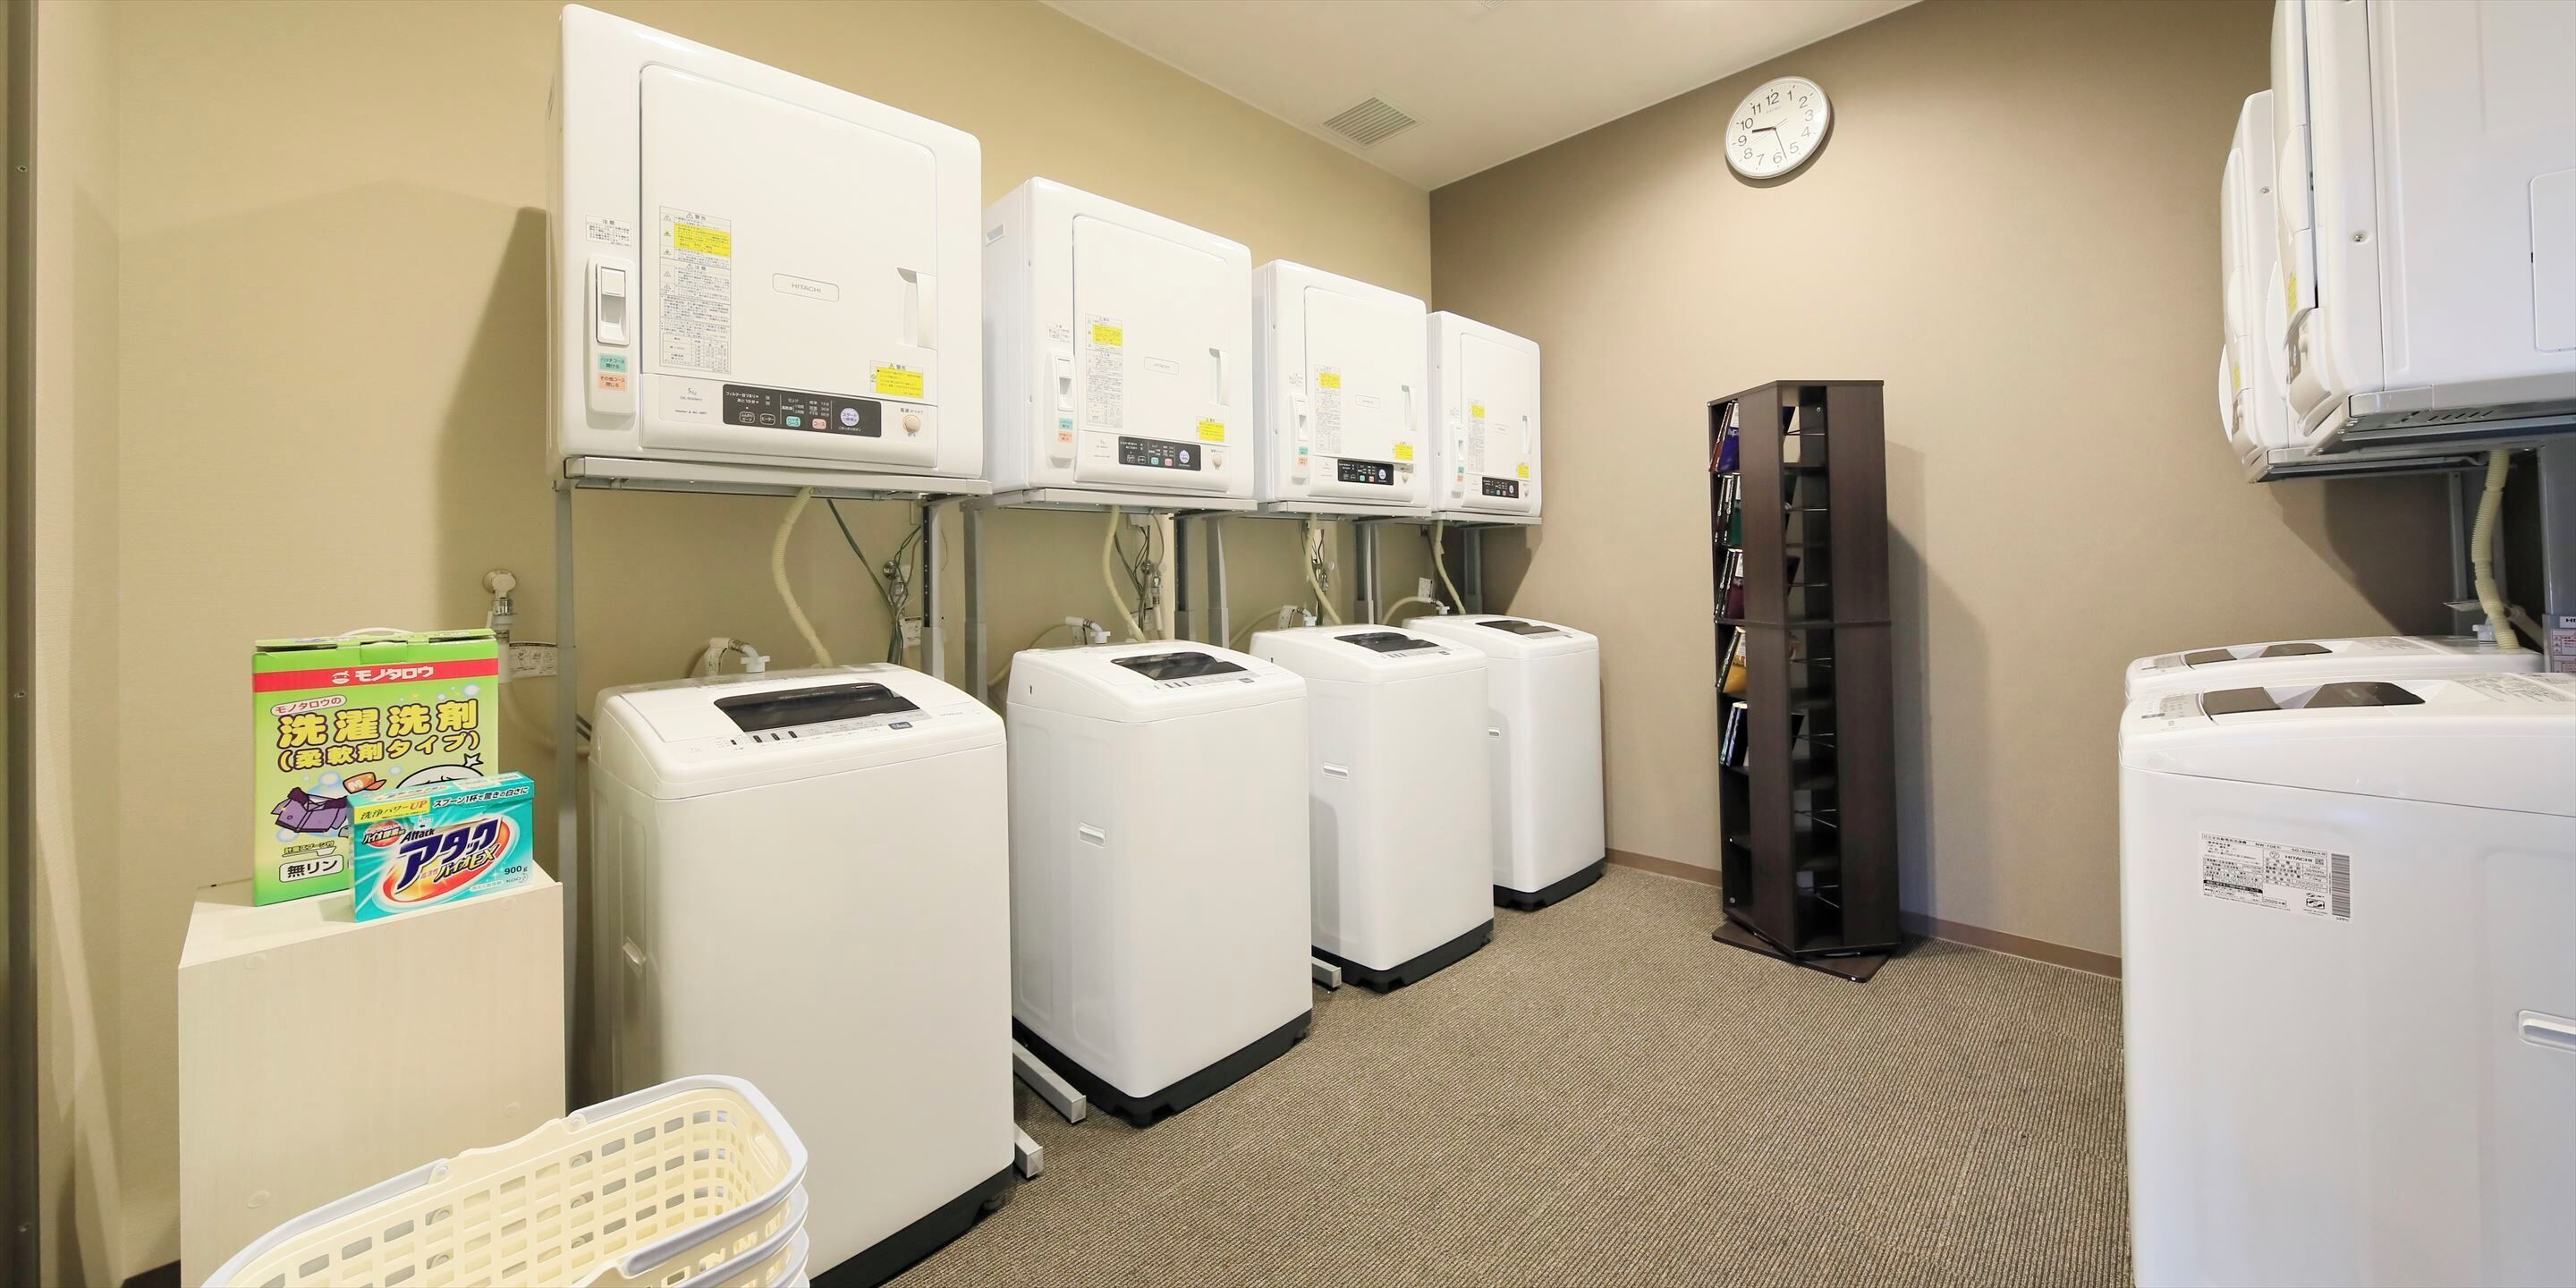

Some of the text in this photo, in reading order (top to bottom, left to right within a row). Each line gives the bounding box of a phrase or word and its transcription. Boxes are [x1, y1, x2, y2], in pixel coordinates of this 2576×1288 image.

[1766, 92, 1780, 106] 12
[1787, 90, 1792, 100] 1
[1751, 103, 1761, 114] 11
[1799, 96, 1808, 108] 2
[1805, 109, 1814, 122] 3
[1740, 117, 1754, 131] 10
[1801, 126, 1810, 138] 4
[1738, 135, 1747, 147] 9
[1790, 141, 1799, 154] 5
[1743, 148, 1753, 159] 8
[1757, 154, 1765, 165] 7
[1773, 152, 1782, 164] 6
[792, 283, 821, 292] HITACHI
[355, 665, 434, 682] モノタロウ
[275, 697, 342, 714] モノタロウの
[277, 699, 479, 749] 洗濯洗剤
[278, 731, 480, 772] (柔軟剤タイプ)
[433, 787, 529, 808] スプーン1杯で驚きの白さに
[400, 828, 435, 844] Attack
[397, 818, 499, 891] アタック
[2284, 854, 2313, 863] HITACHI
[287, 860, 337, 878] 無リン
[433, 843, 500, 883] バイオEX
